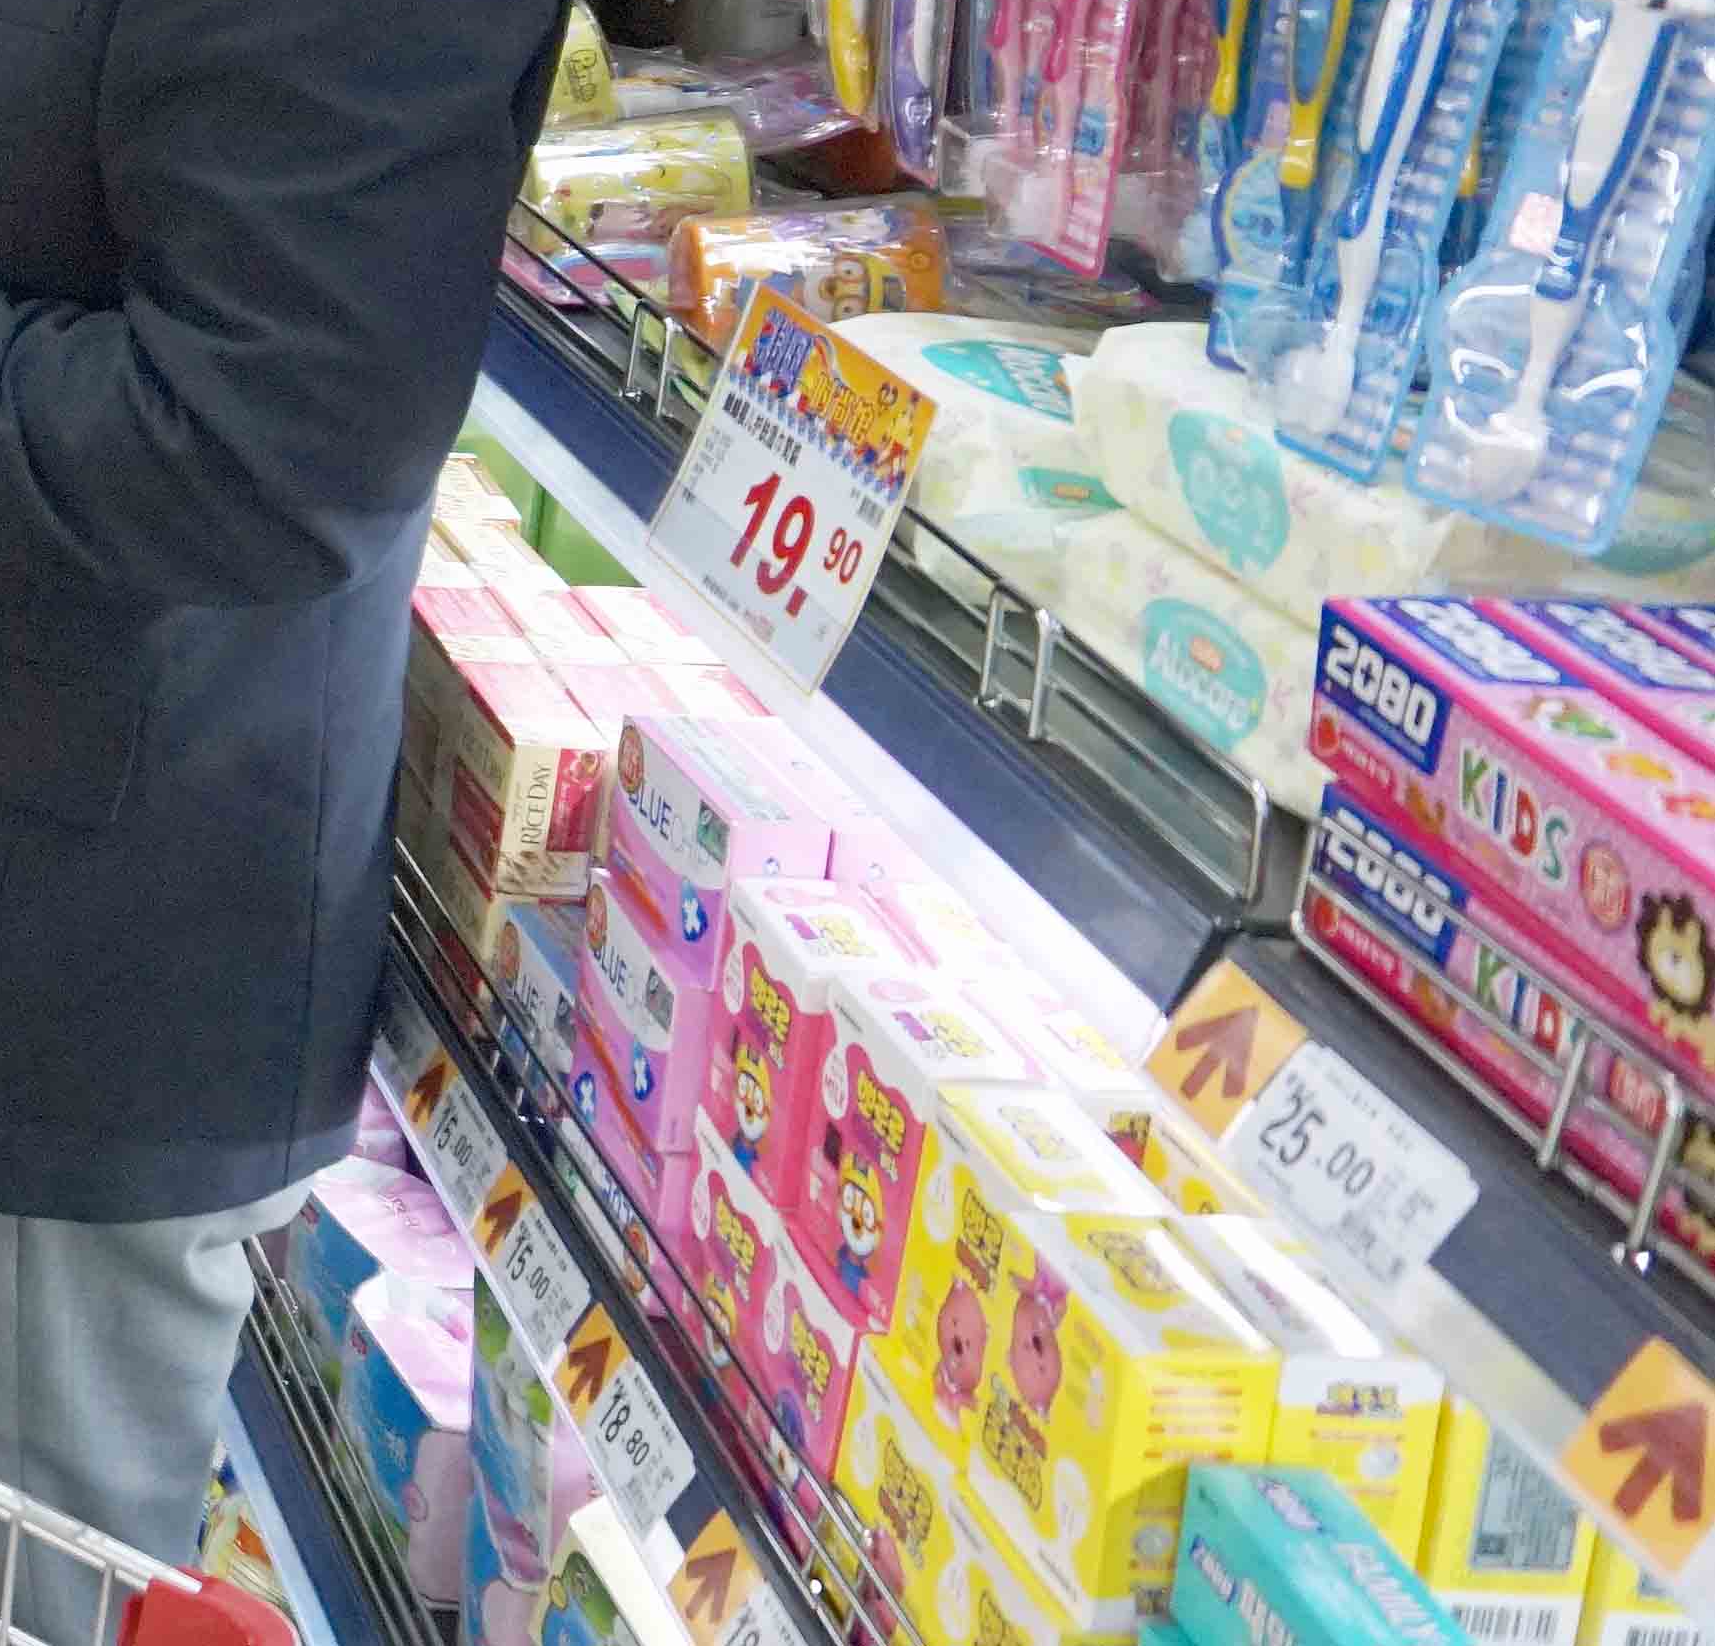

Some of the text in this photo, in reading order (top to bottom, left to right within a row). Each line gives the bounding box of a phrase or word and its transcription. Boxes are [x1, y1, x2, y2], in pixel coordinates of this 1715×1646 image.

[1324, 623, 1438, 748] 2080
[1458, 744, 1570, 884] KIDS
[1259, 1094, 1376, 1196] 25.00
[506, 1234, 552, 1300] 15.00
[599, 1392, 650, 1466] 18.80
